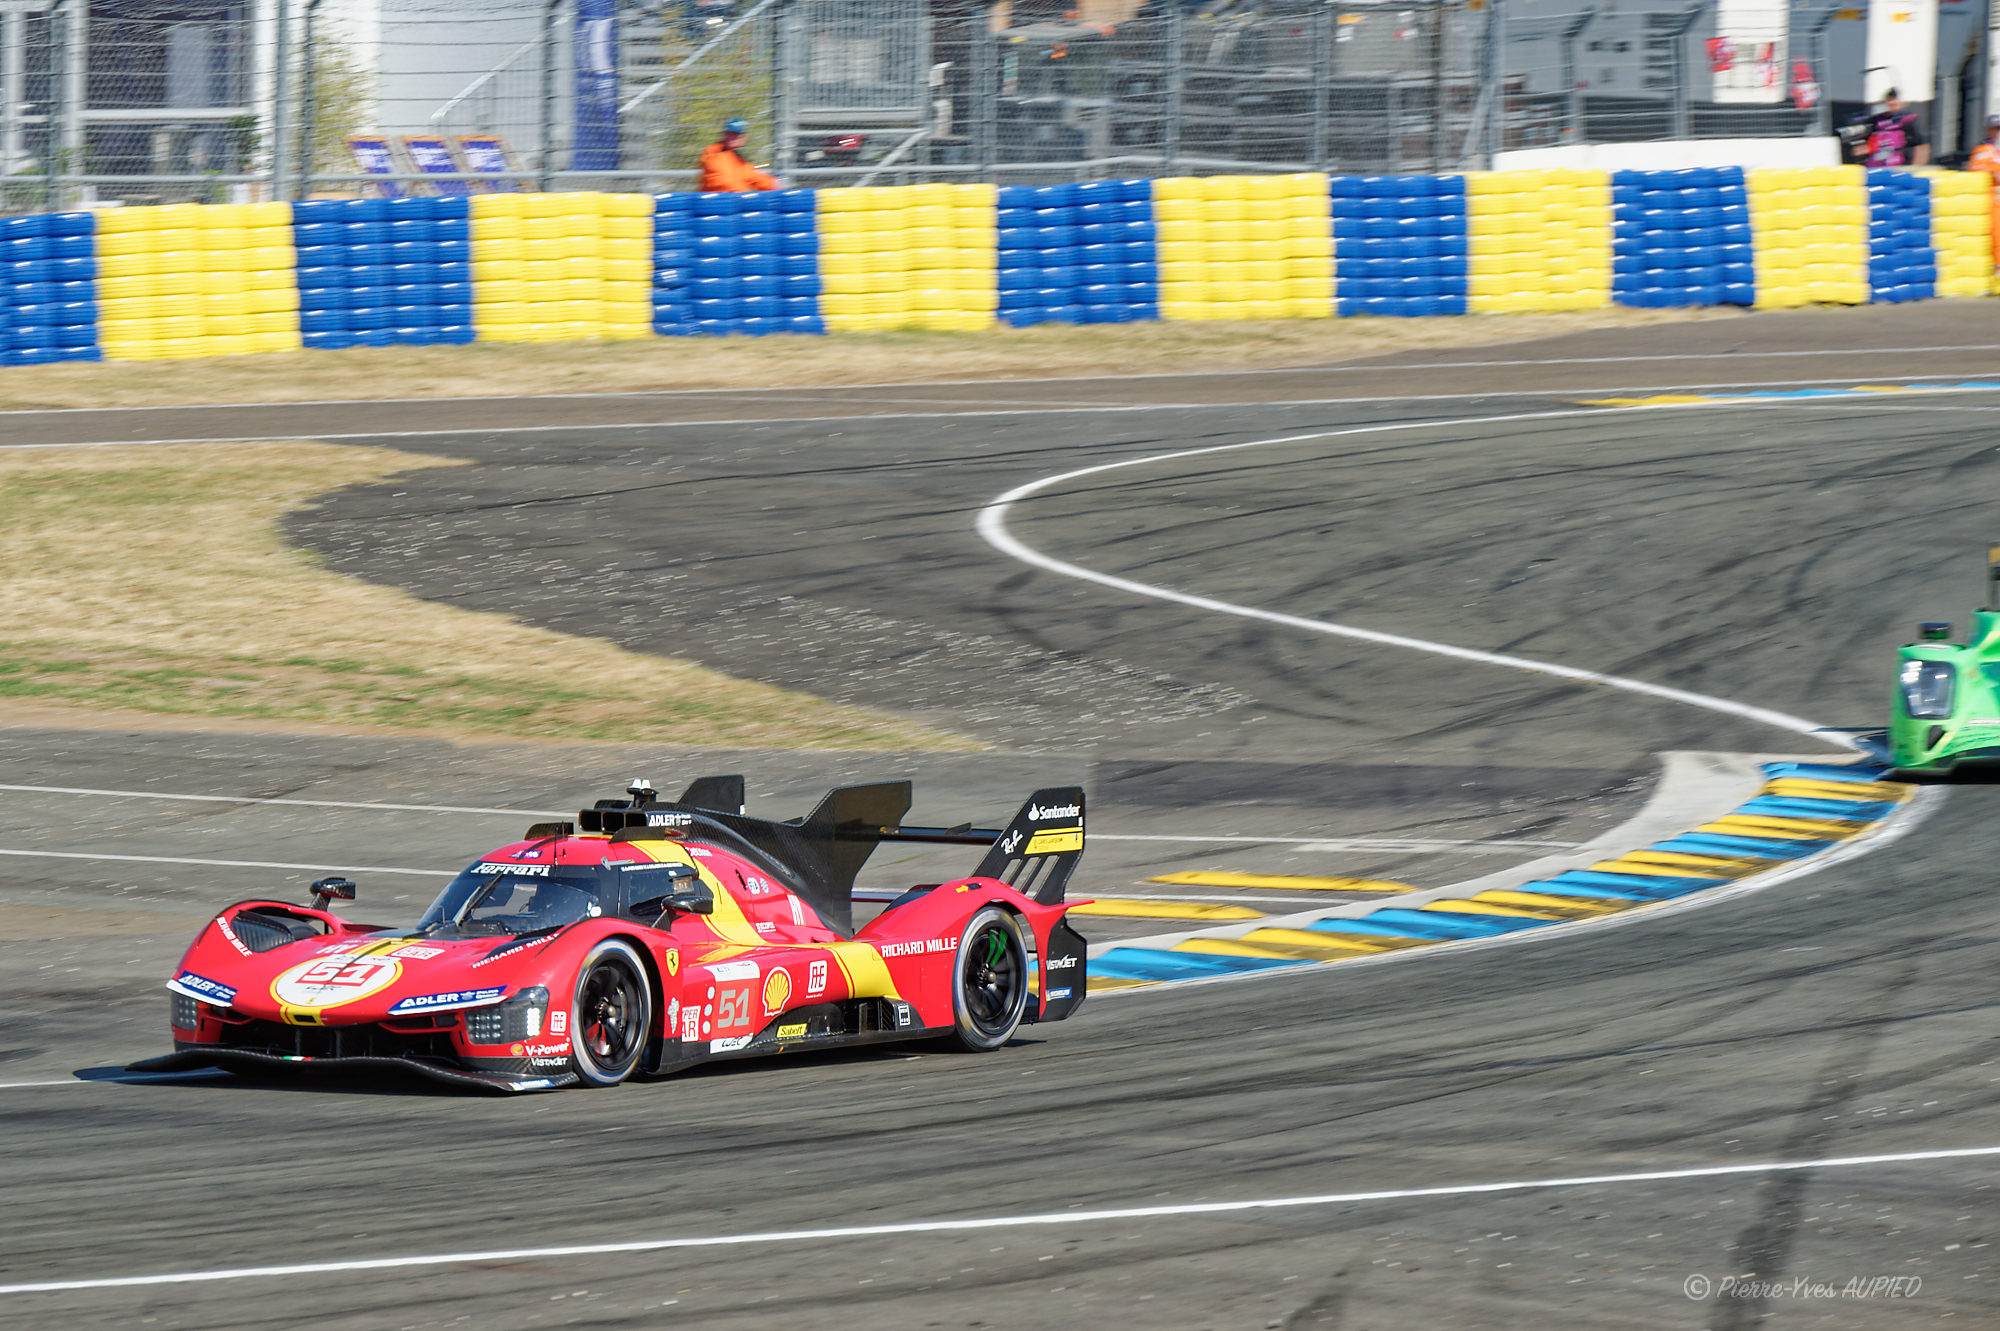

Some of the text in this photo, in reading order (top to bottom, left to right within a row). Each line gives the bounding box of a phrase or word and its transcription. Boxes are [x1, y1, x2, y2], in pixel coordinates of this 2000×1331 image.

[1039, 803, 1080, 819] Santander
[648, 814, 675, 826] ADLER
[470, 862, 551, 877] Ferrari
[881, 937, 957, 958] RICHARD MILLE
[301, 962, 375, 984] 51
[400, 993, 460, 1008] ADLER
[718, 988, 750, 1028] 51
[525, 1042, 569, 1056] V-Power
